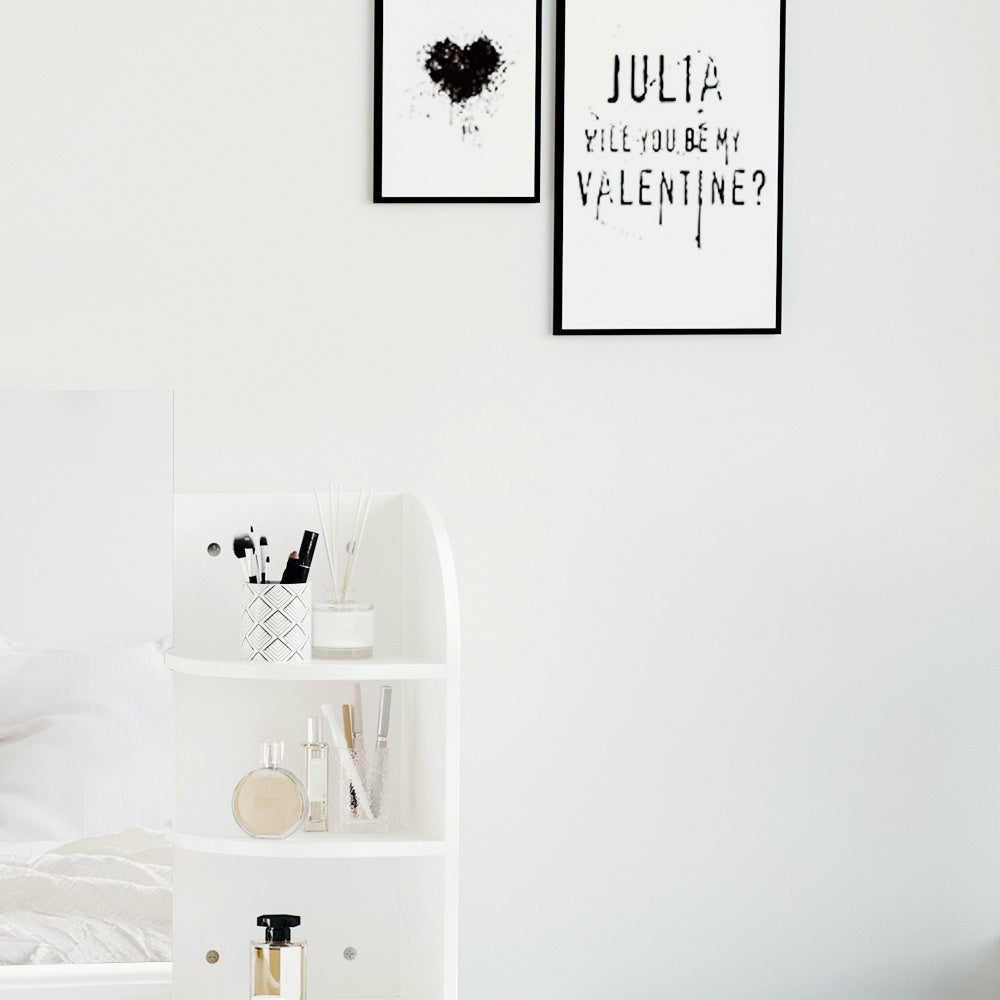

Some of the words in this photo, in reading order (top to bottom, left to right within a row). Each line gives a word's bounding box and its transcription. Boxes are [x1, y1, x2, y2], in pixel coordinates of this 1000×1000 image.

[607, 55, 722, 103] JULIA
[641, 128, 676, 152] YOU
[685, 124, 708, 152] BE
[716, 127, 740, 157] MY
[577, 169, 766, 211] VALENTINE?
